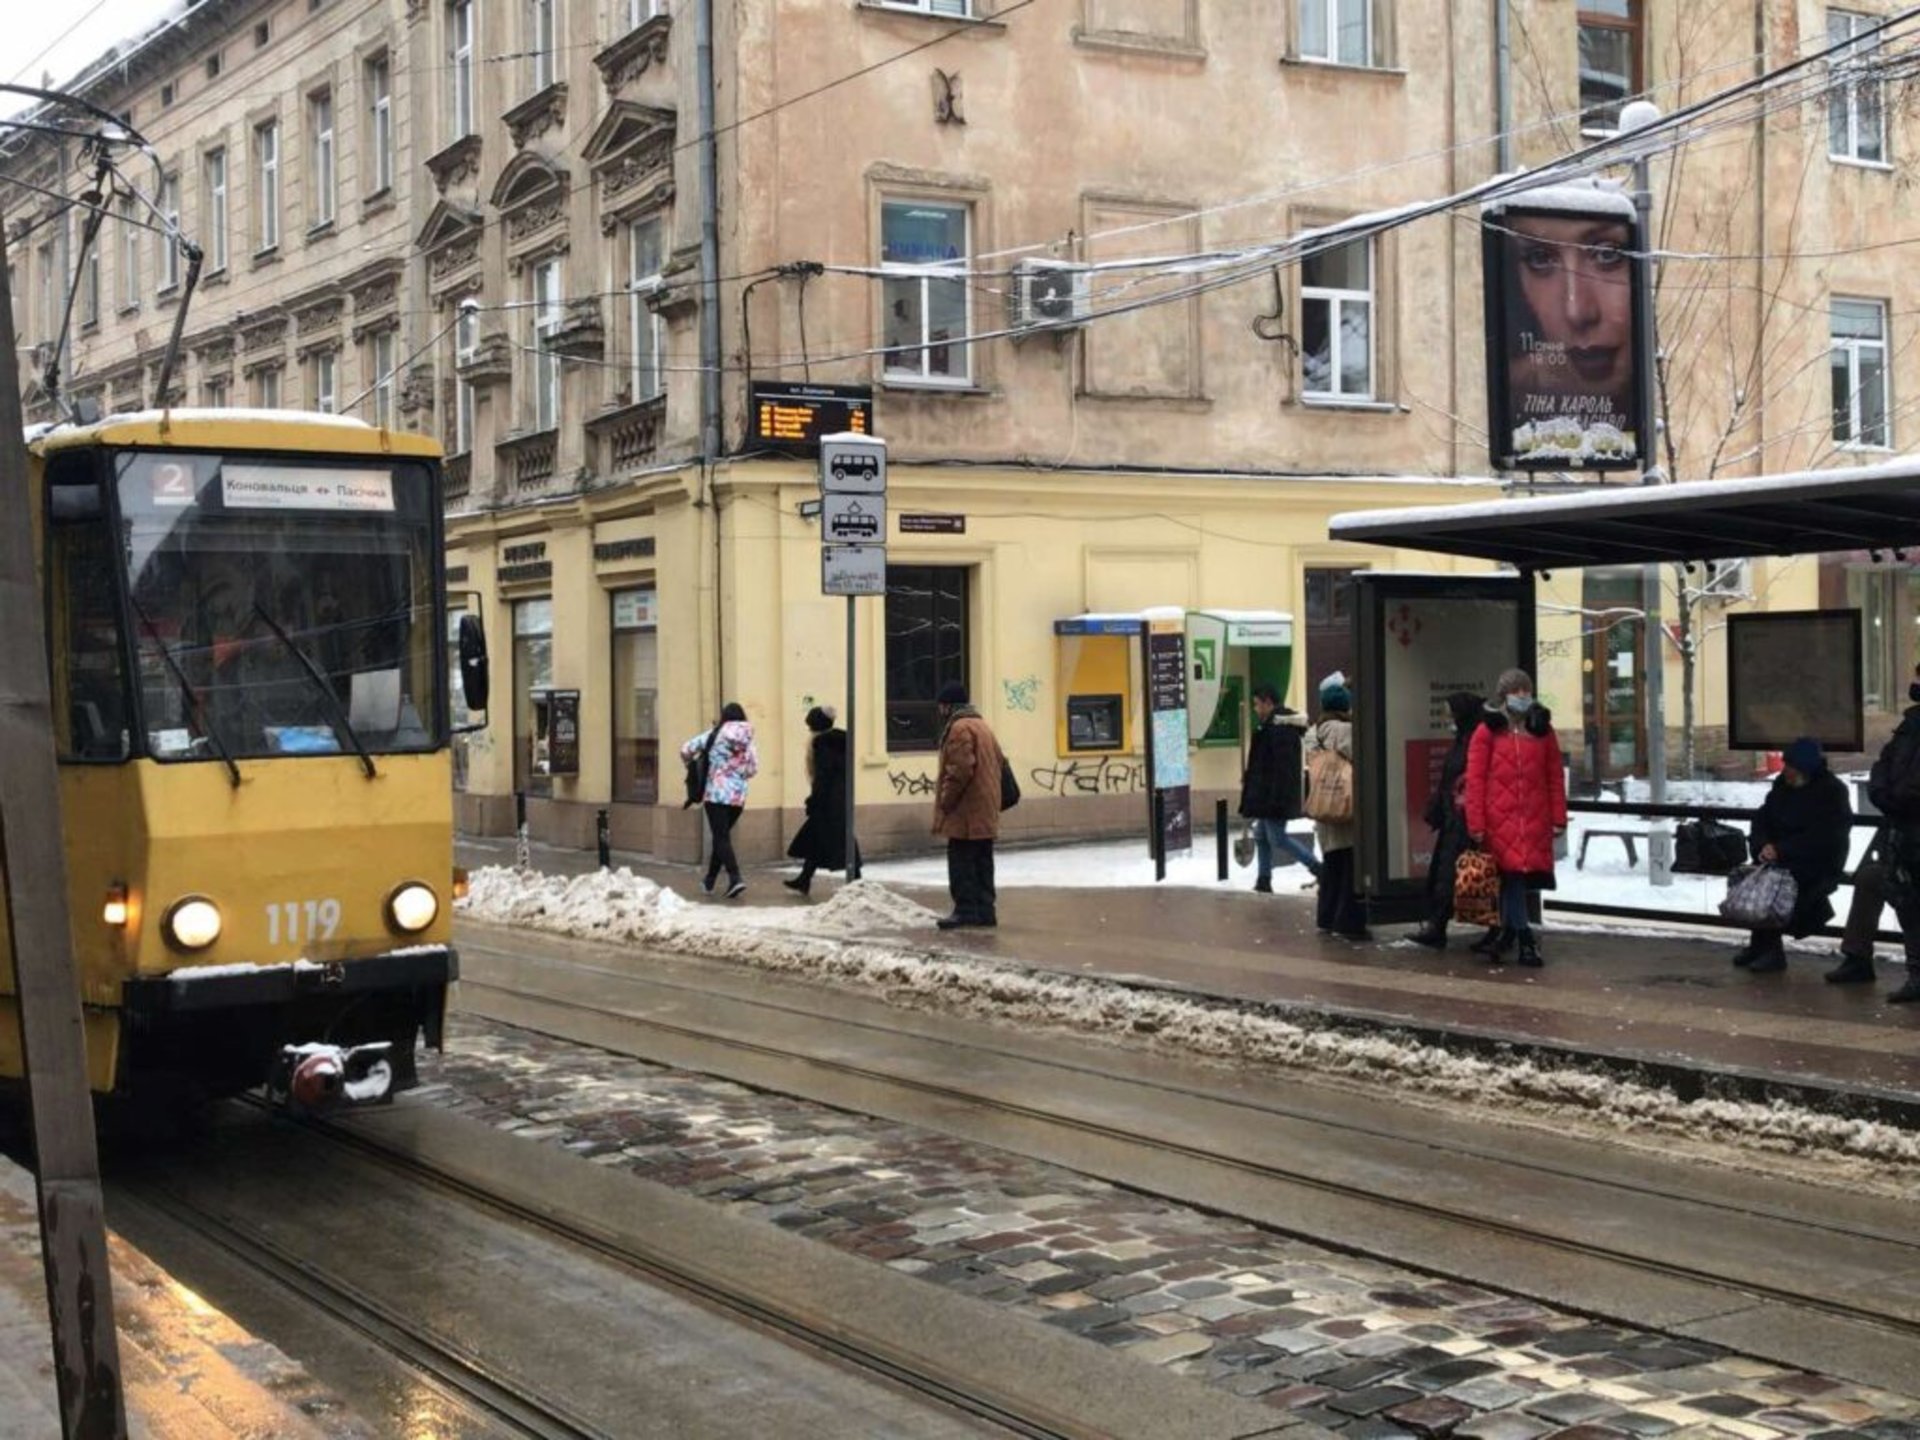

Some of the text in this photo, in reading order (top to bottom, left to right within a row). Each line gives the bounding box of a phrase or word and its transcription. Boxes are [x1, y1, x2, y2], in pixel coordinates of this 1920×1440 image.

[1560, 395, 1613, 414] КАРОЛЬ
[161, 463, 185, 493] 2
[226, 478, 309, 496] Коновальця
[264, 899, 341, 945] 1119
